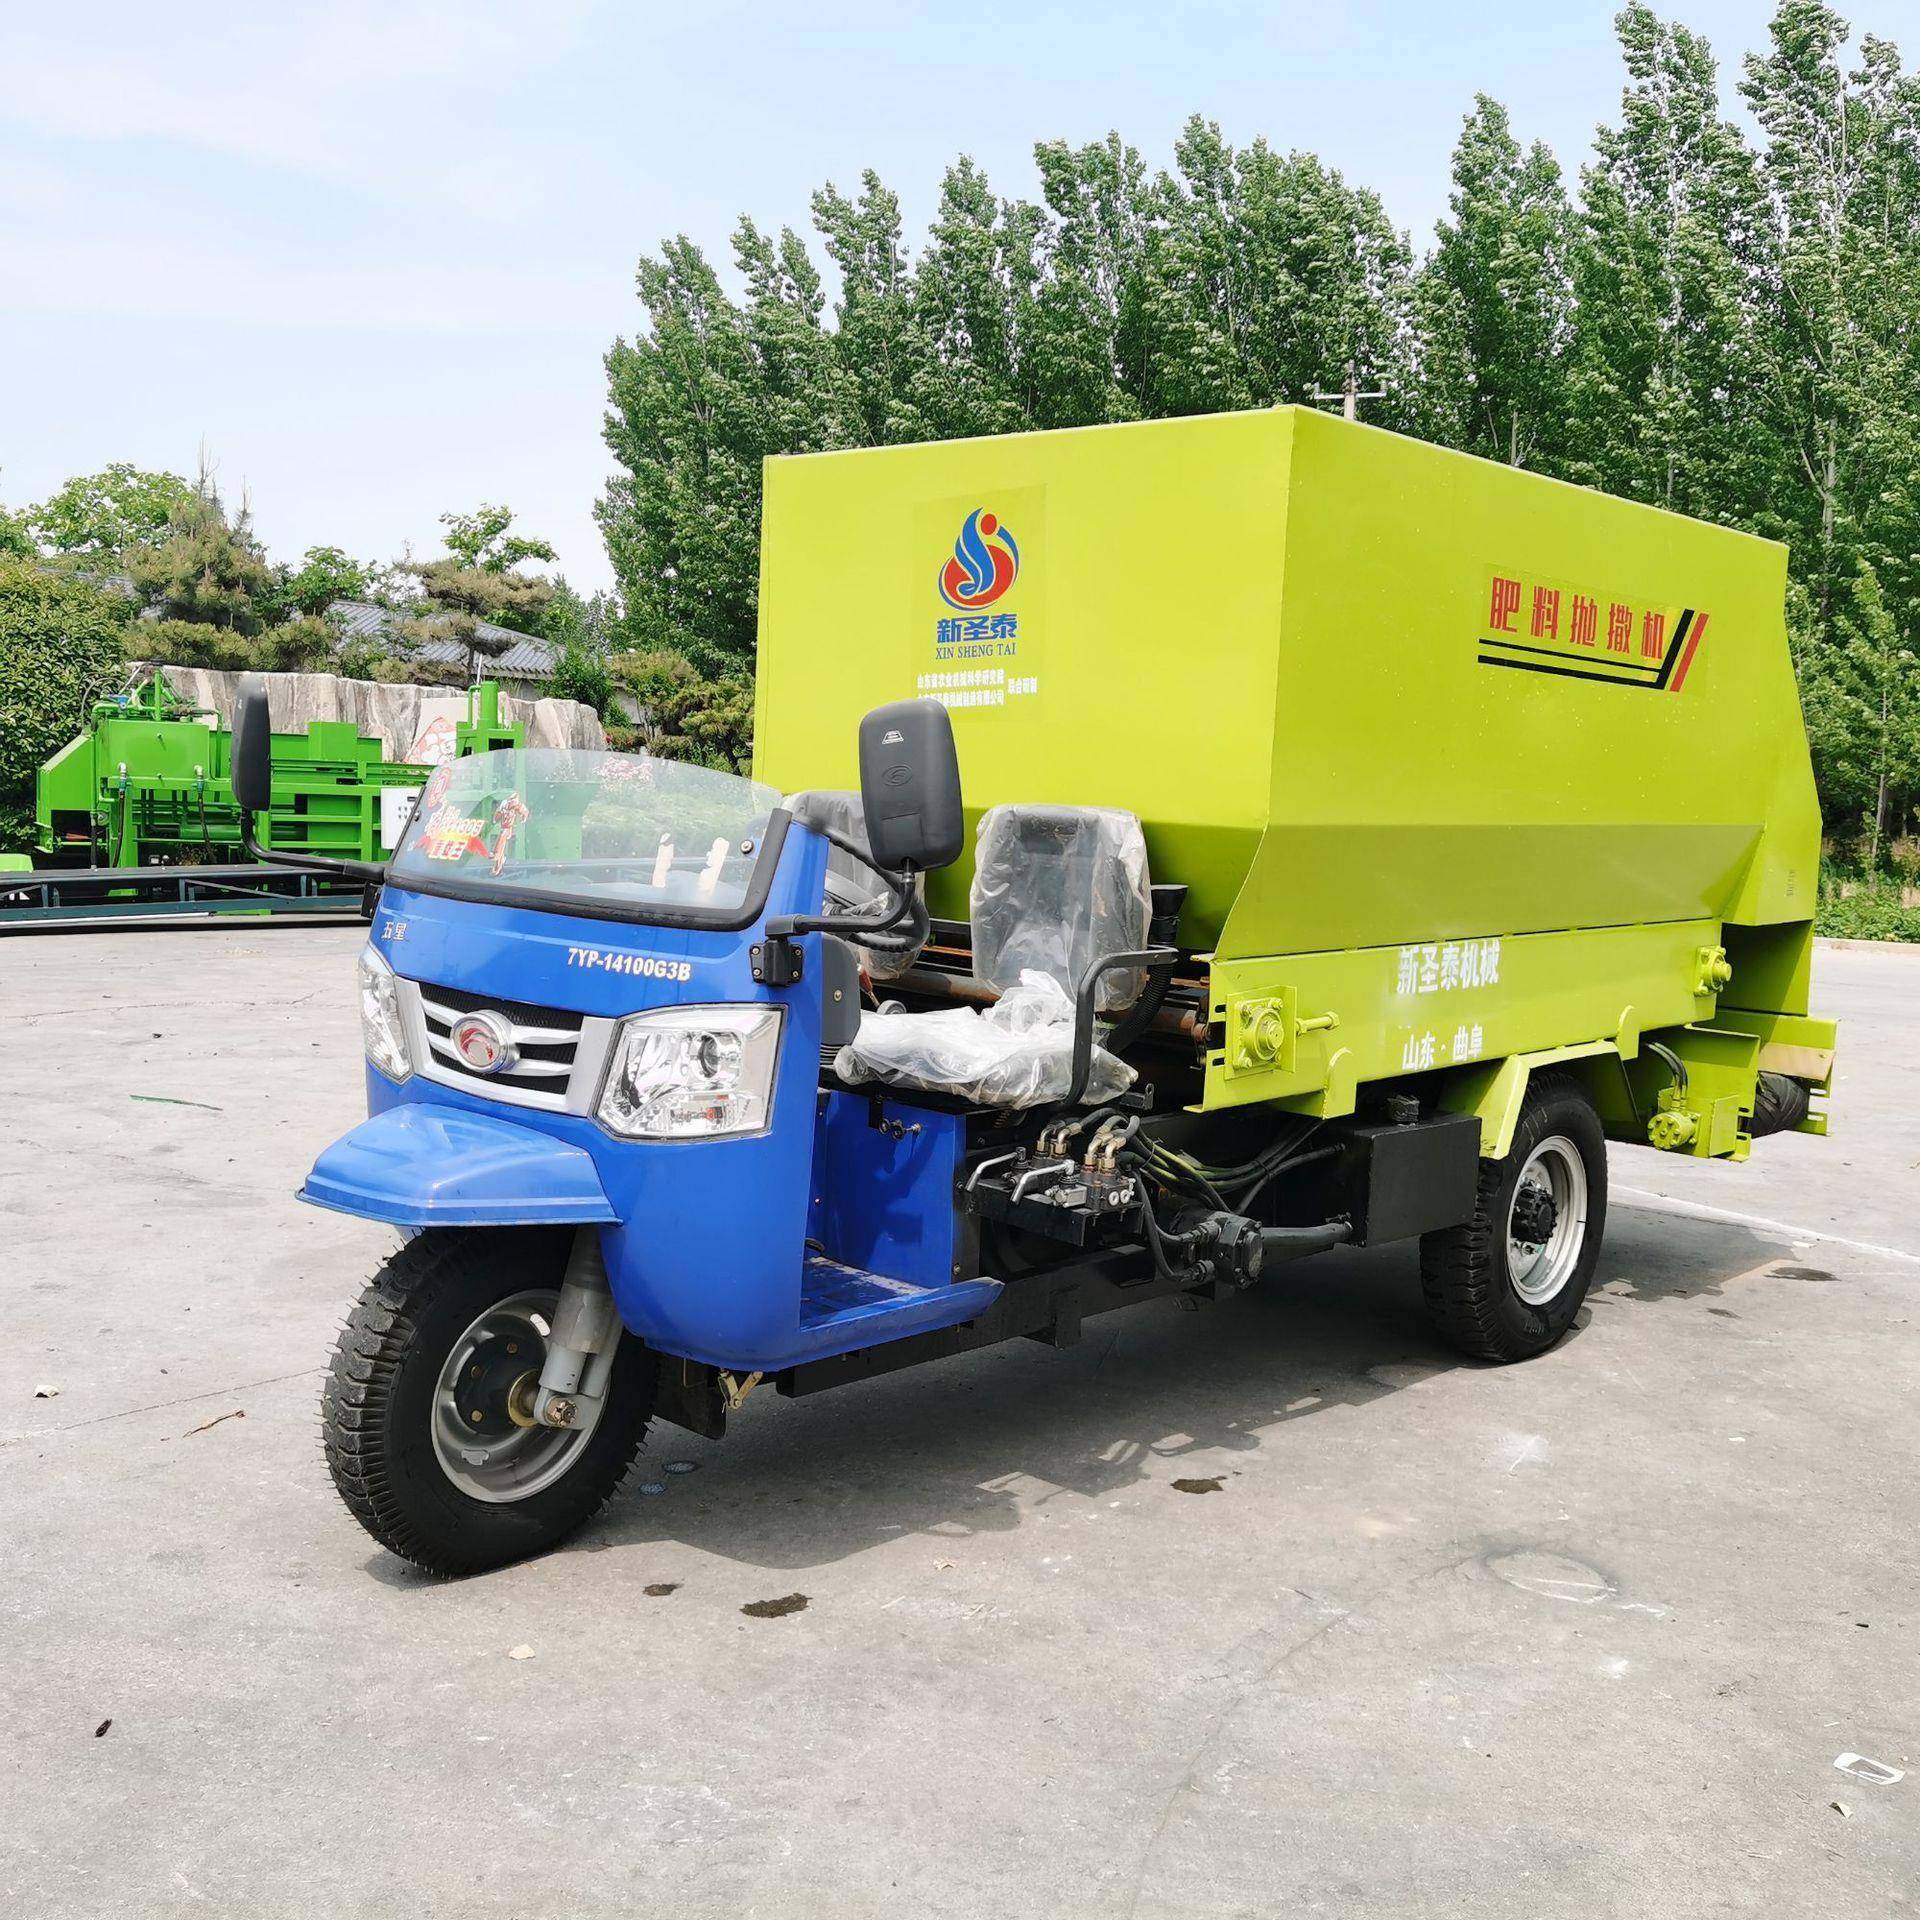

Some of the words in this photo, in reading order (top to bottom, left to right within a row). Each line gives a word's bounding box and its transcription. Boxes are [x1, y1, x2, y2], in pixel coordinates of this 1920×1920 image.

[937, 613, 1018, 643] 新圣泰
[935, 646, 955, 660] XIN
[957, 643, 994, 659] SHENG
[996, 642, 1017, 656] TAI
[567, 947, 691, 982] 7YP-14100G3B
[1397, 939, 1500, 995] 新圣泰机械
